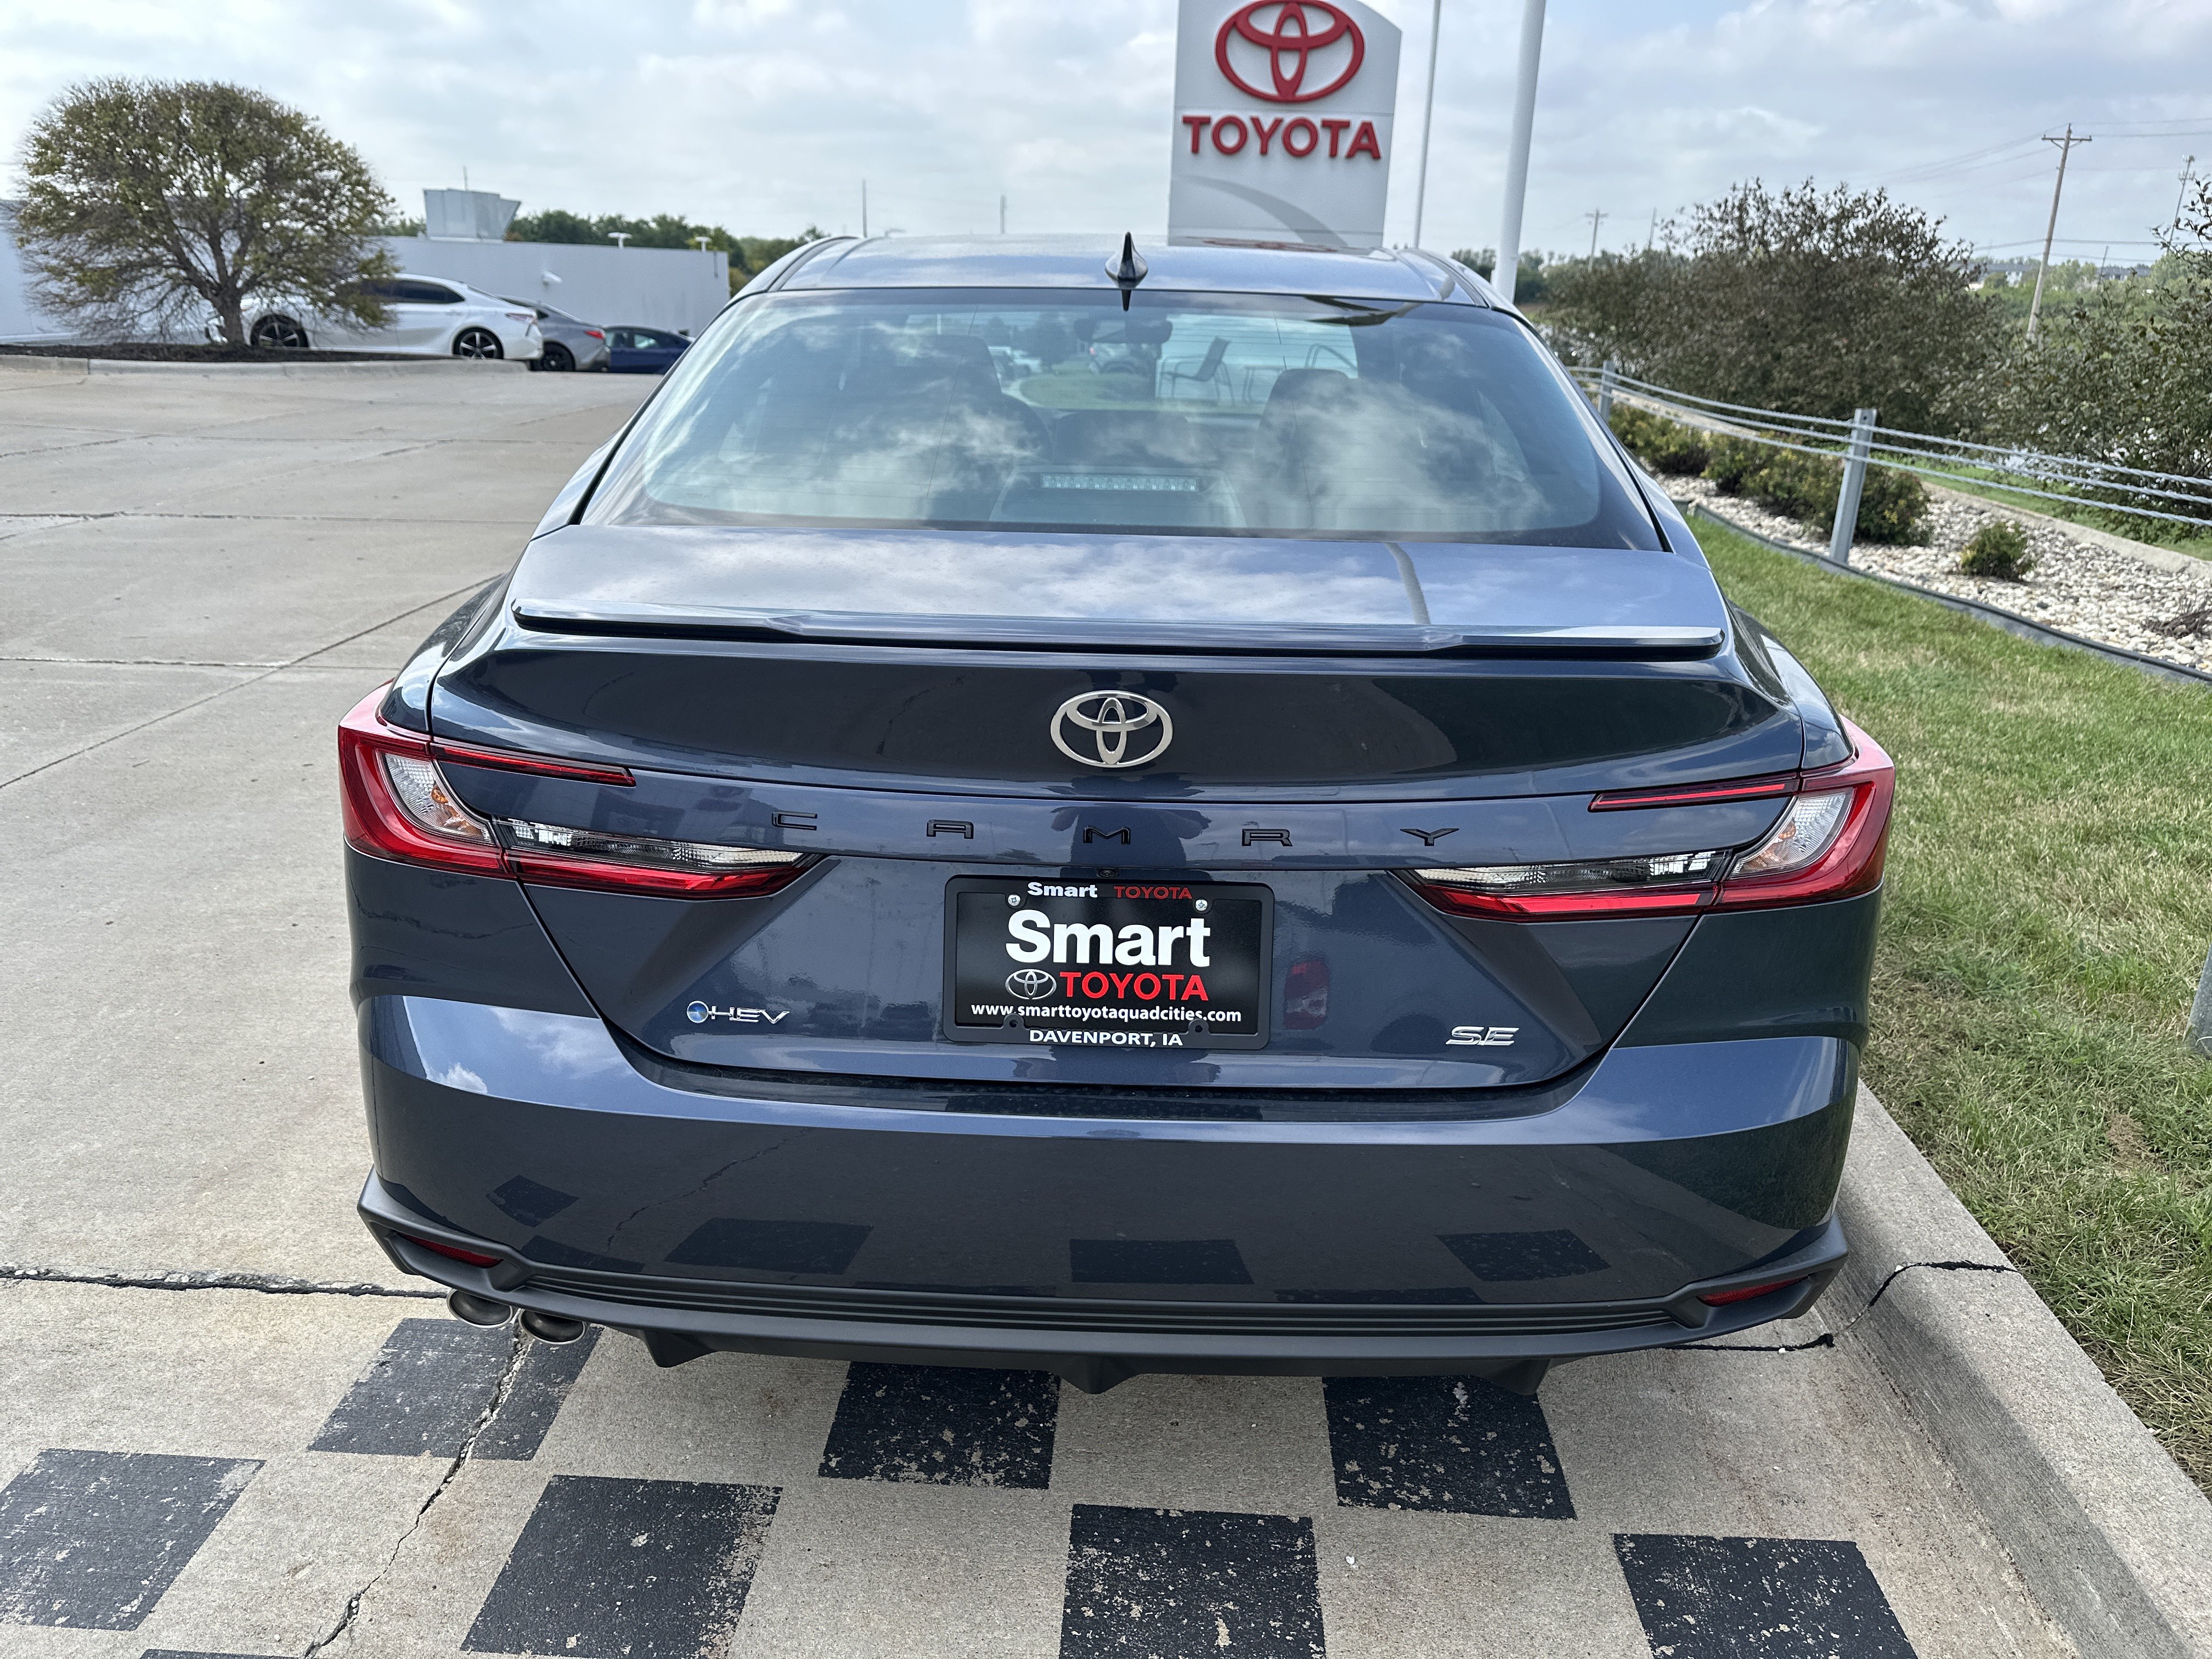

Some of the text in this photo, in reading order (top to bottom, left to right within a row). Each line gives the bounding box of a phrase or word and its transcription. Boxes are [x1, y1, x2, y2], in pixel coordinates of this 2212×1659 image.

[1182, 115, 1381, 159] TOYOTA
[771, 811, 1459, 847] CAMRY
[1027, 882, 1193, 899] Smart TOYOTA
[1006, 909, 1211, 967] Smart
[1060, 971, 1209, 1001] TOYOTA
[972, 1005, 1242, 1023] www.smarttoyotaquadcities.com
[1029, 1030, 1183, 1047] DAVENPORT, IA
[1445, 1025, 1520, 1046] SE
